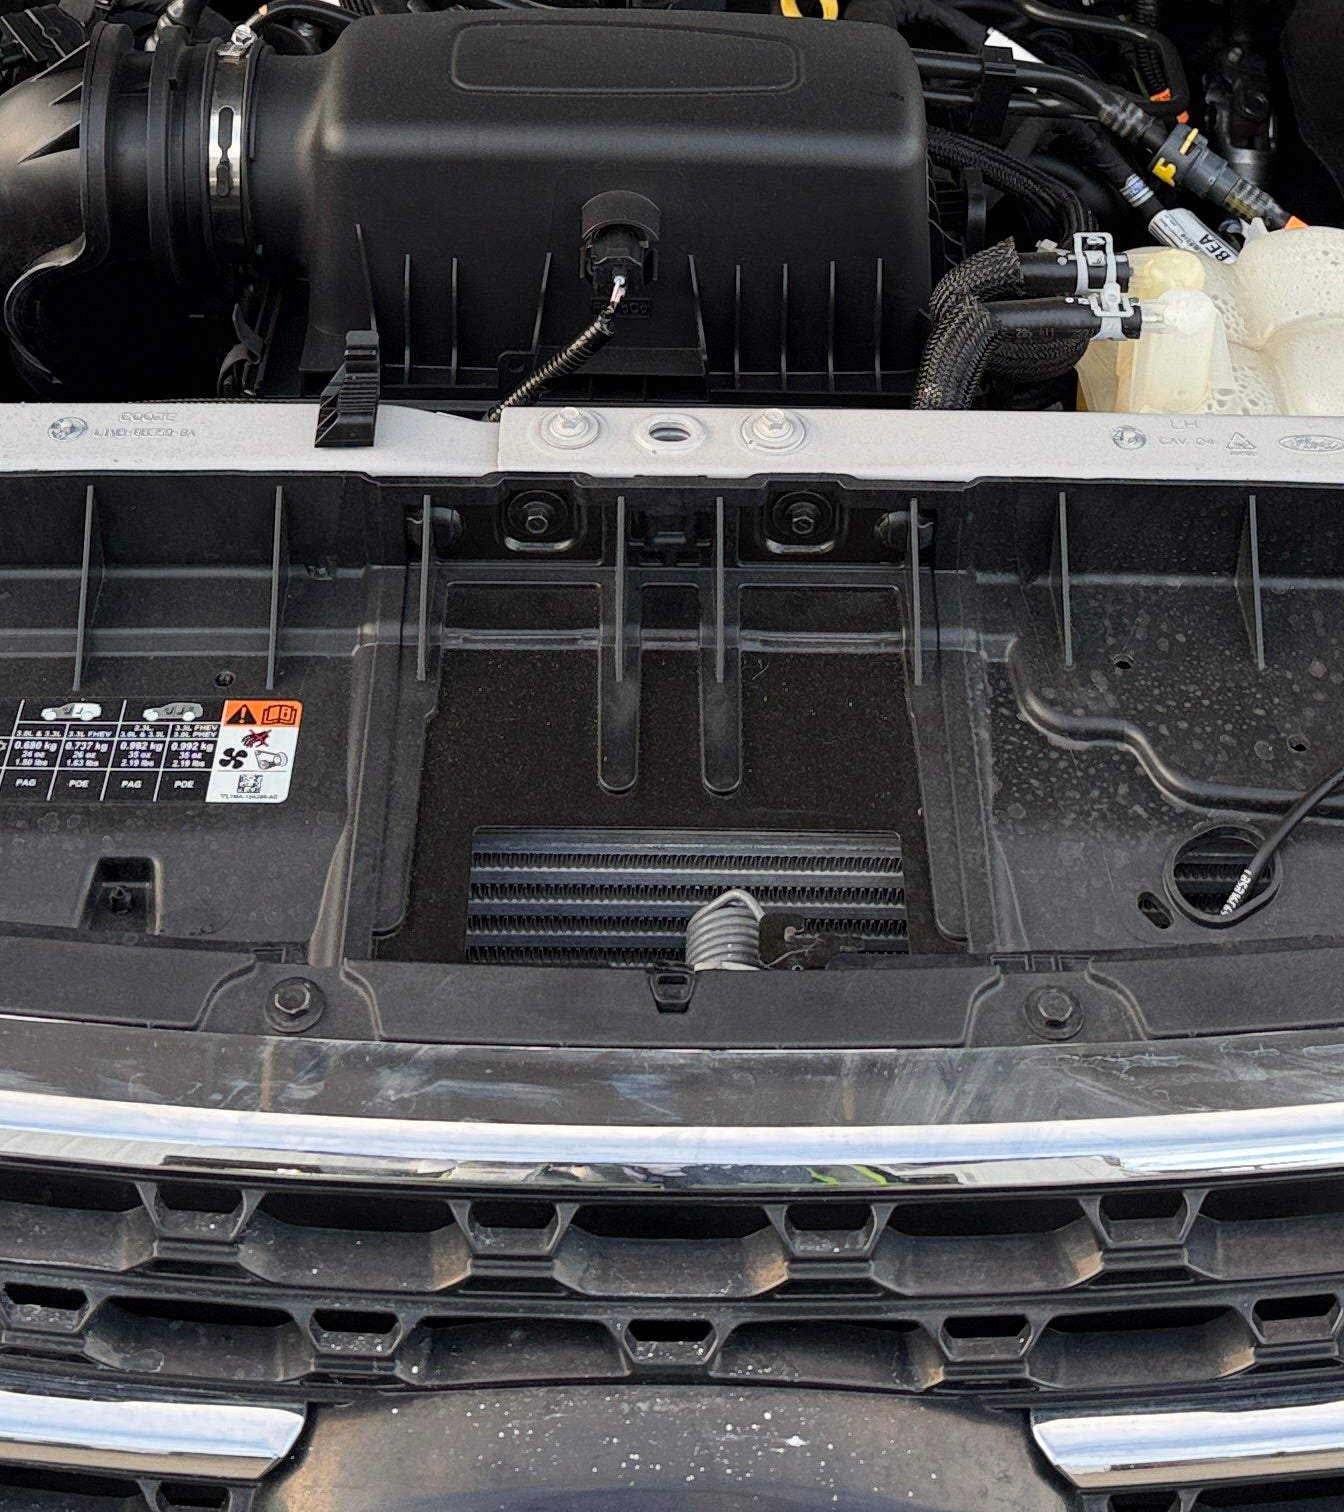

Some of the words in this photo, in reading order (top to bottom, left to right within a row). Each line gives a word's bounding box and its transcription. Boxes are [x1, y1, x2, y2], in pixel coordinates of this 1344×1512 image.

[1199, 234, 1231, 261] BEA
[1169, 419, 1201, 430] LH
[44, 741, 57, 752] kg
[65, 742, 93, 750] 0.737
[94, 742, 109, 752] kg
[120, 742, 148, 750] 0.992
[150, 742, 163, 752] kg
[171, 742, 199, 750] 0.992
[200, 742, 214, 752] kg
[120, 759, 140, 767] 2.19
[141, 759, 154, 767] lbs
[15, 778, 37, 787] PAG
[67, 779, 90, 788] POE
[120, 780, 143, 789] PAG
[173, 780, 195, 789] POE
